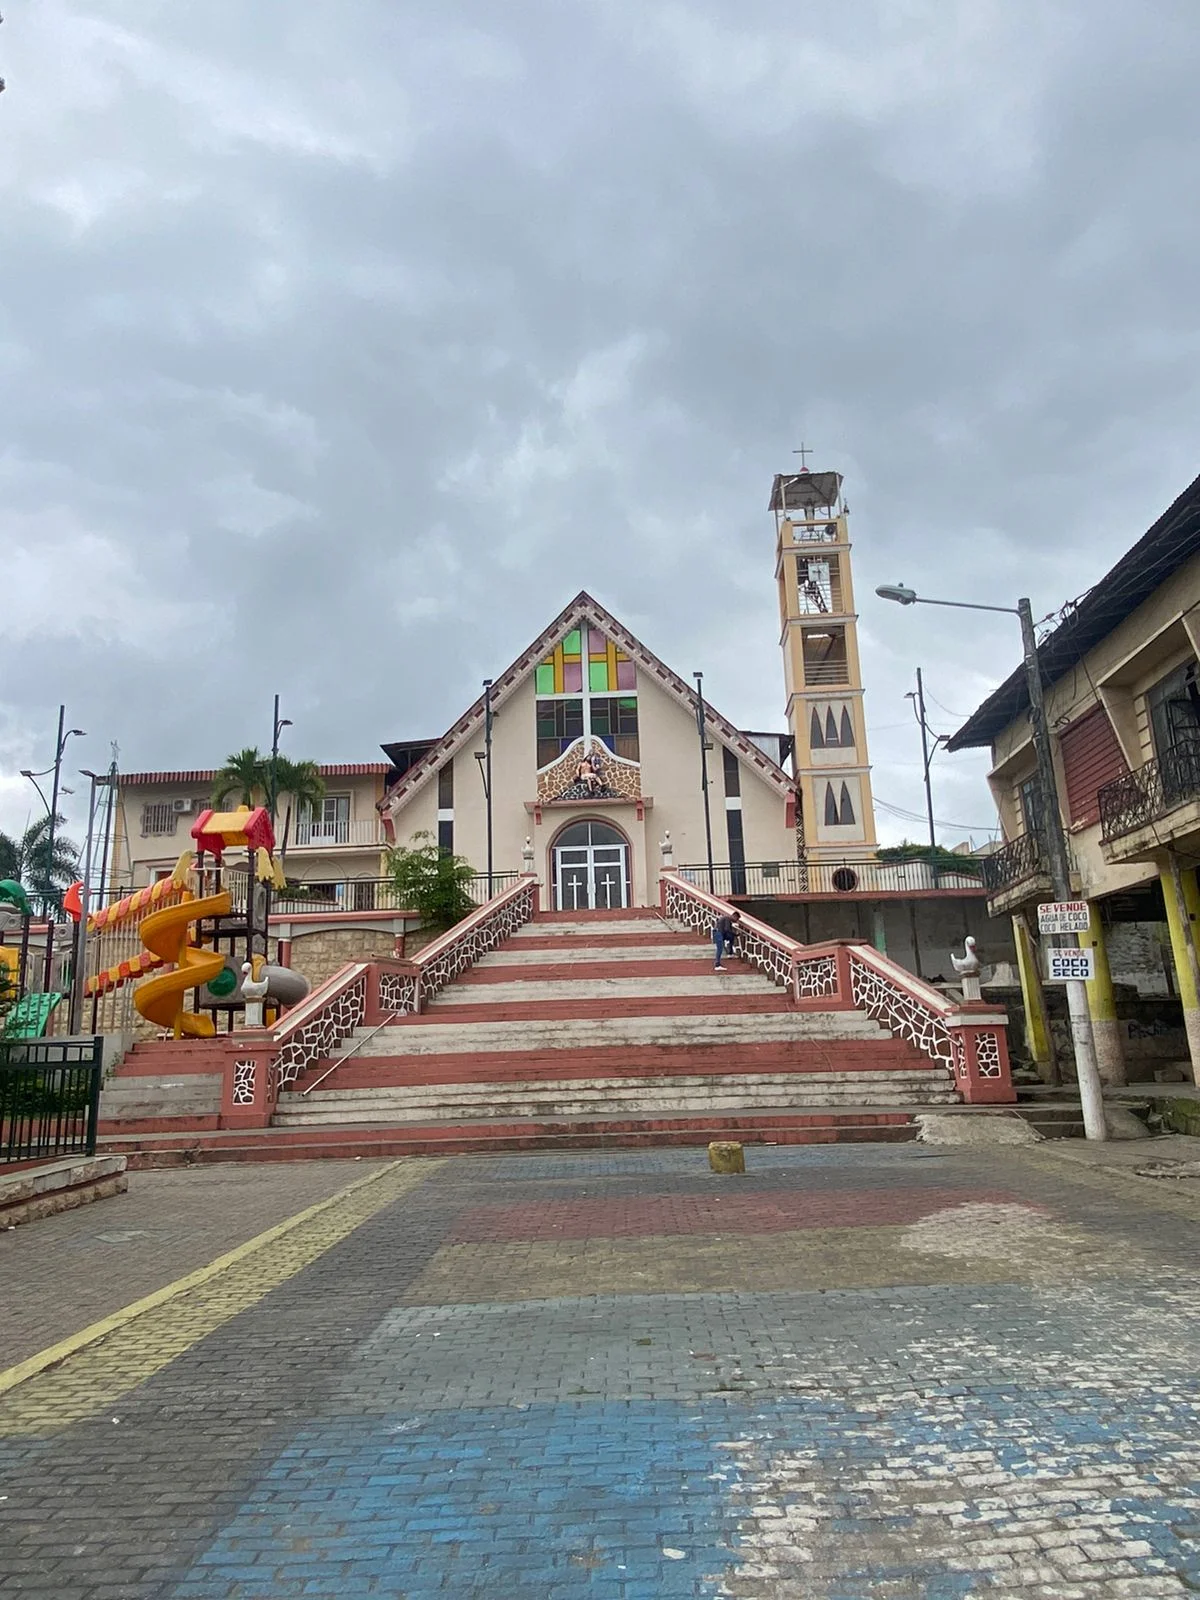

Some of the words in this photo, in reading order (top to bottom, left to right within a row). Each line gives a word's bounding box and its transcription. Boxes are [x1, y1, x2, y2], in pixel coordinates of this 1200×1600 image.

[1040, 904, 1051, 913] SE
[1054, 903, 1086, 912] VENDE
[1040, 914, 1058, 923] AGUA
[1068, 912, 1087, 921] COCO
[1040, 924, 1056, 933] COCO
[1060, 923, 1088, 931] HELADO
[1053, 959, 1088, 967] COCO
[1053, 968, 1089, 977] SECO
